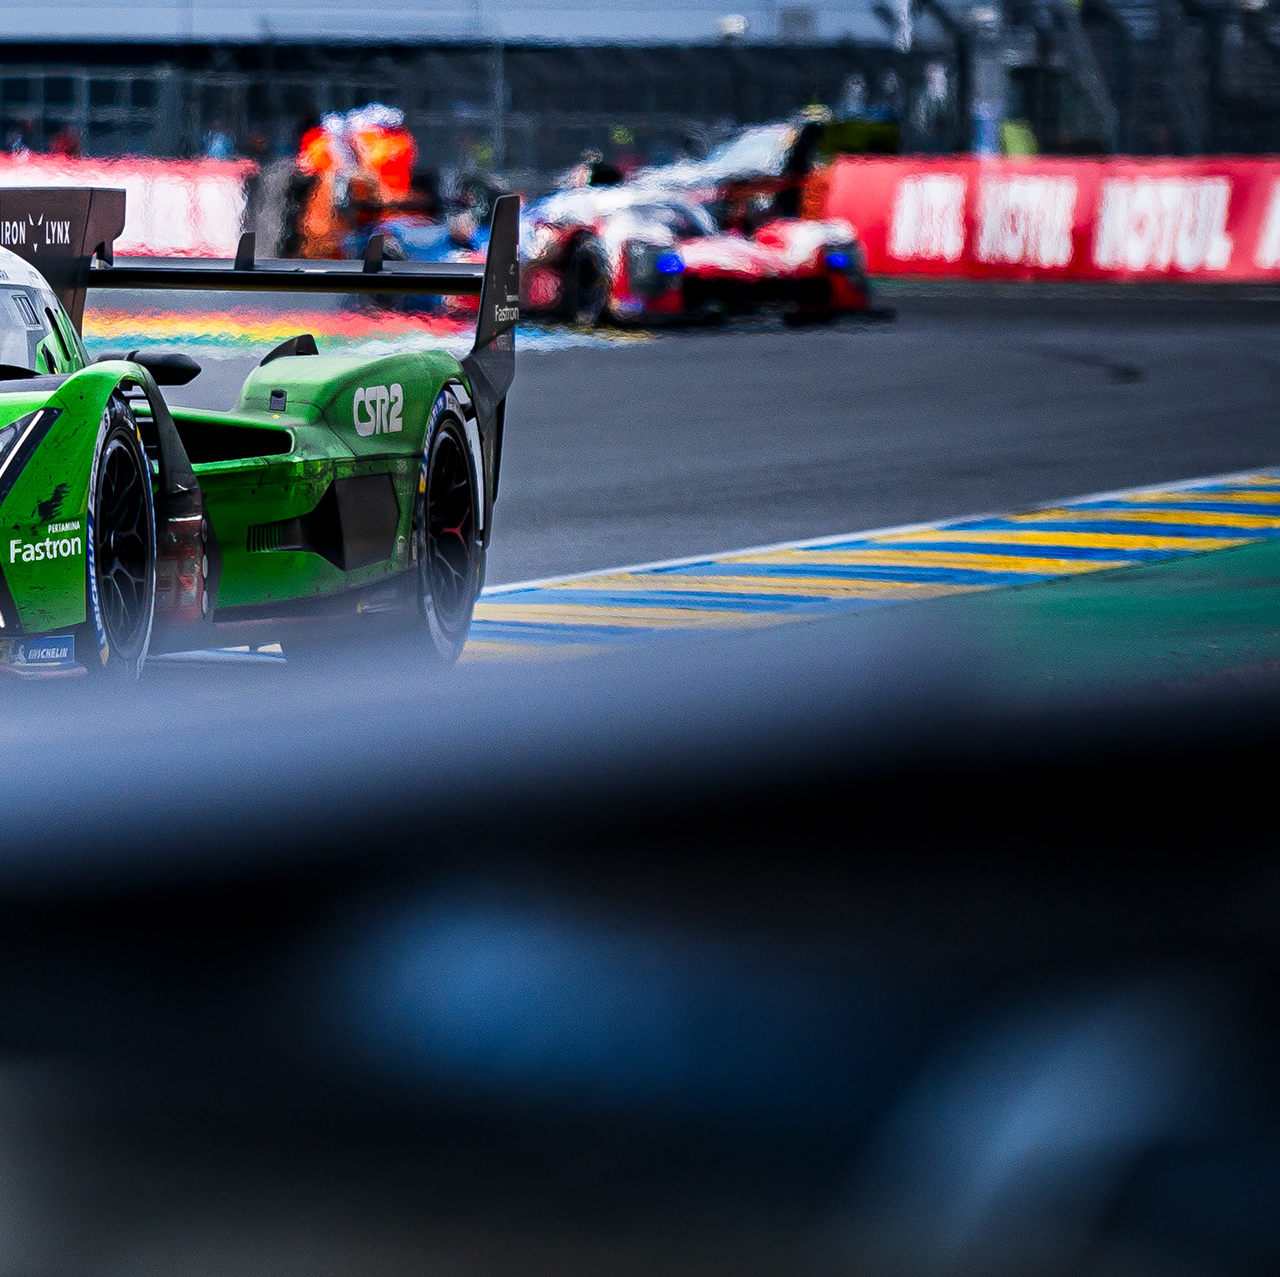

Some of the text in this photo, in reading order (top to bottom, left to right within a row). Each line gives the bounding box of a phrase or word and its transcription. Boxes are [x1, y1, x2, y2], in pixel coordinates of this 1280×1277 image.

[1, 221, 71, 245] IRON LYNX
[495, 305, 519, 322] Fastron
[353, 383, 403, 437] CSR2
[47, 521, 81, 534] PERTAMINA
[10, 537, 81, 563] Fastron
[28, 647, 68, 660] MICHELIN
